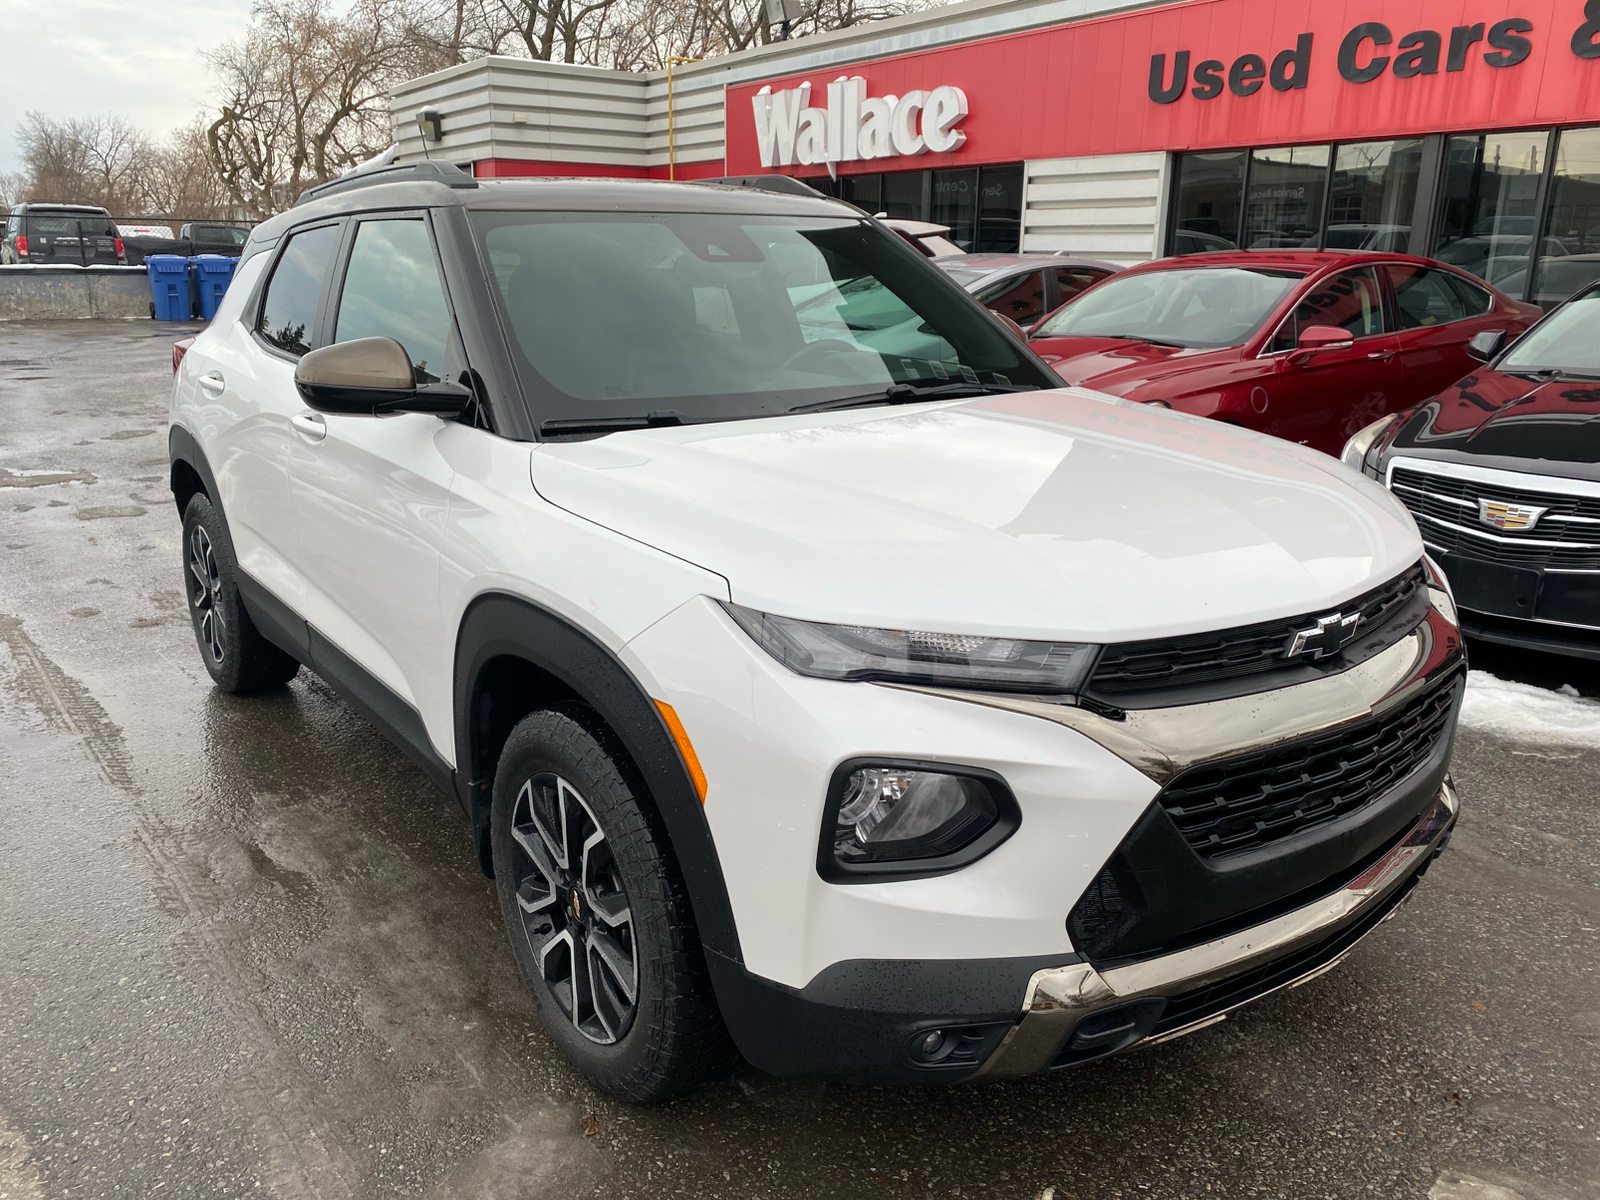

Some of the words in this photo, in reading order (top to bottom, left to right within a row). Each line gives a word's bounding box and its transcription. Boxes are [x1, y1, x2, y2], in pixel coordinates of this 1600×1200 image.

[1147, 32, 1313, 104] Used
[1337, 17, 1533, 84] Cars
[752, 78, 969, 168] Wallace
